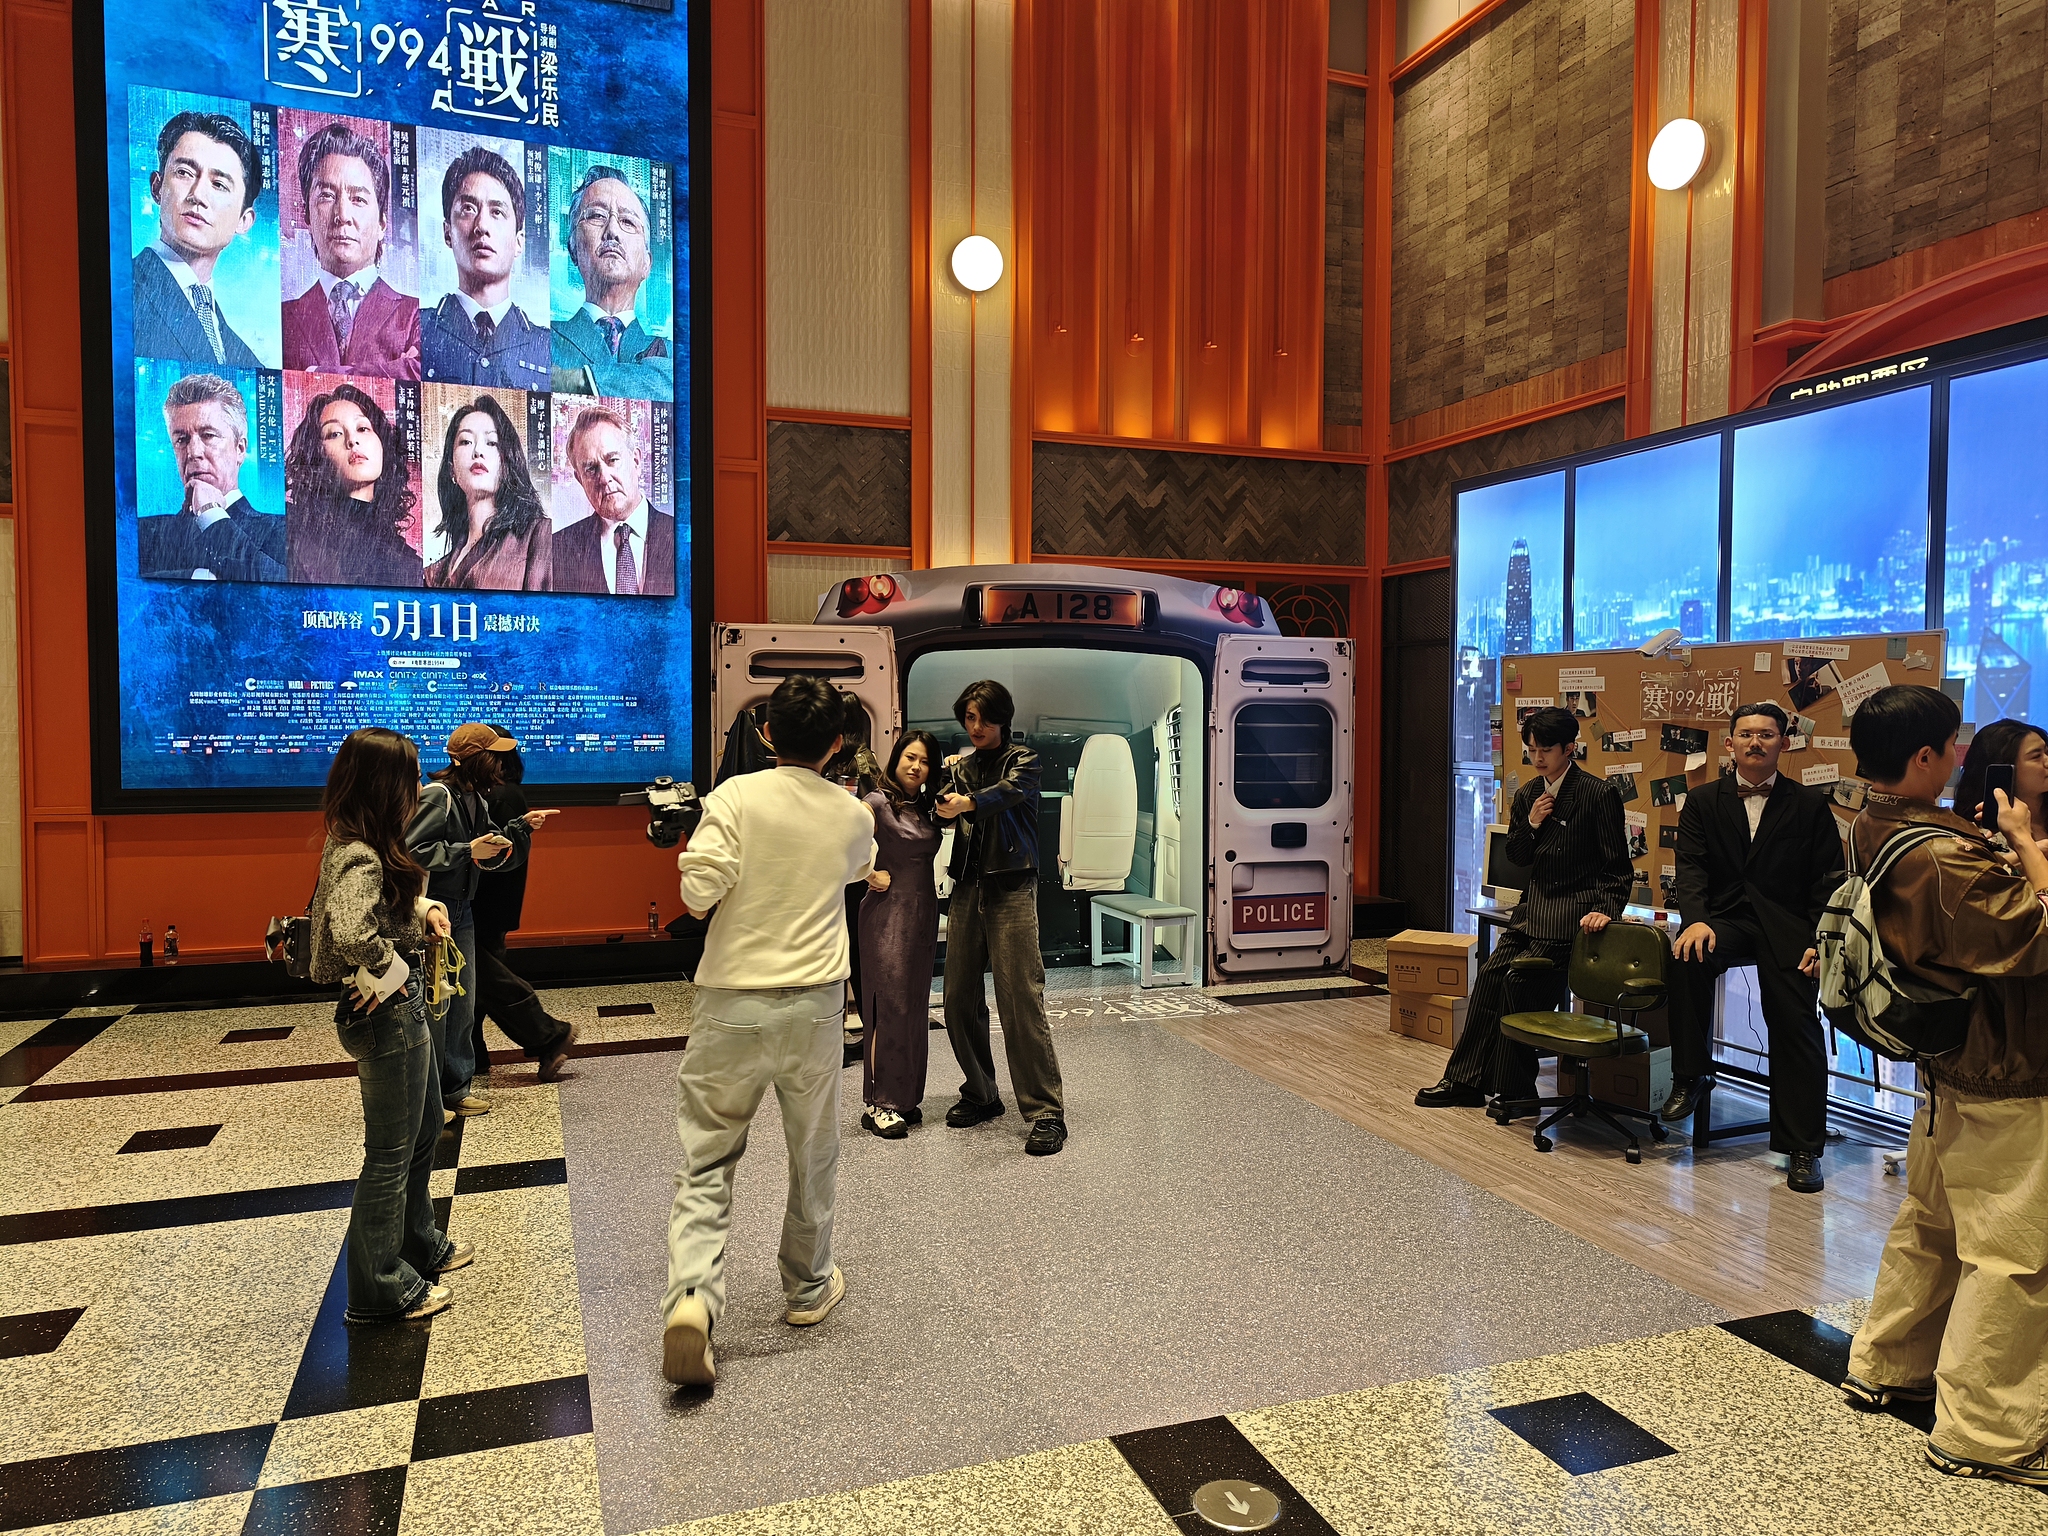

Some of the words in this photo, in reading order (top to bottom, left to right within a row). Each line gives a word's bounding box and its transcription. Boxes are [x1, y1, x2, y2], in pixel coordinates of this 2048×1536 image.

[540, 50, 559, 127] 梁乐民
[1019, 592, 1040, 619] A
[1056, 593, 1113, 620] 128
[302, 610, 363, 629] 顶配阵容
[370, 599, 478, 642] 5月1日
[483, 613, 541, 633] 震撼对决
[353, 670, 384, 679] IMAX
[389, 671, 418, 679] CINITY
[1640, 671, 1689, 679] COLD
[1696, 669, 1740, 678] WAR
[1242, 902, 1315, 924] POLICE
